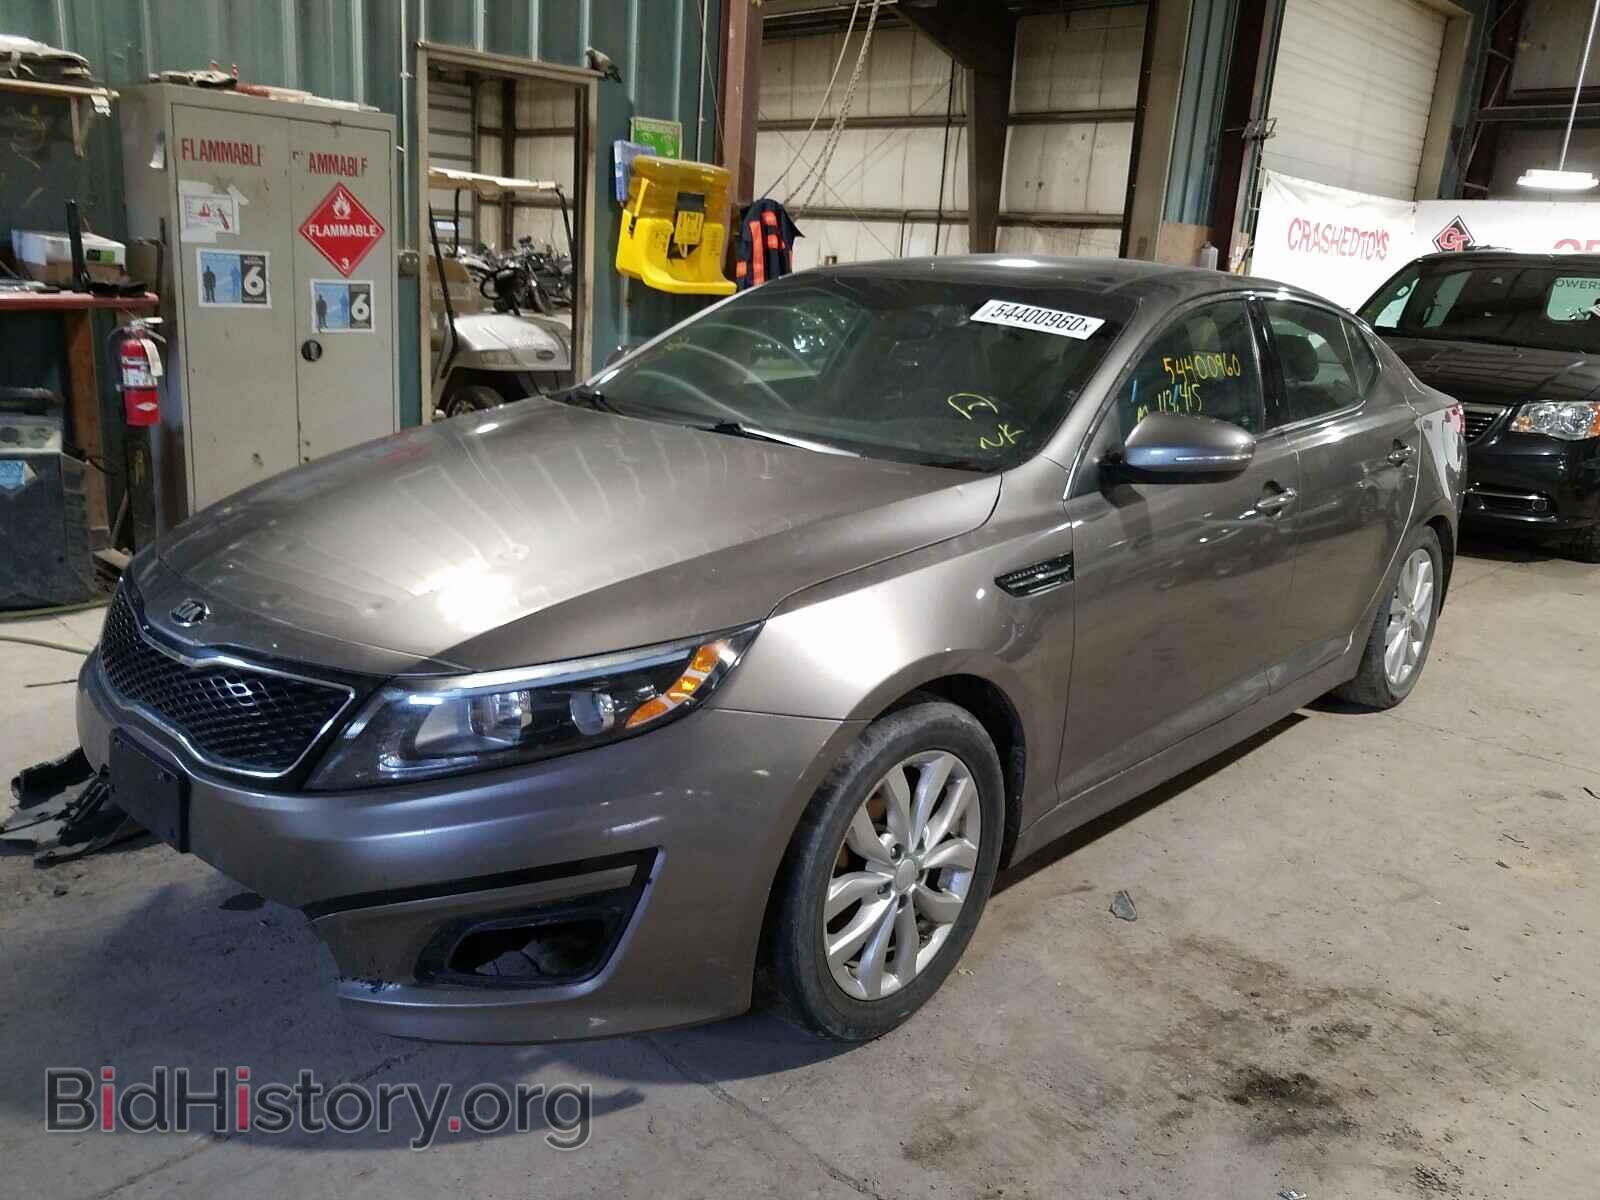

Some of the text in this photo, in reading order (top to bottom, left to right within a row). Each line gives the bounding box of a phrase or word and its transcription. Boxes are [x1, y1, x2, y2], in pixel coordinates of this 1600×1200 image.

[308, 223, 377, 237] FLAMMABLE
[1287, 217, 1390, 262] CRASHEDTOYS
[341, 258, 350, 270] 3
[243, 266, 265, 296] 6
[351, 292, 370, 321] 6
[1162, 352, 1241, 385] 54400960
